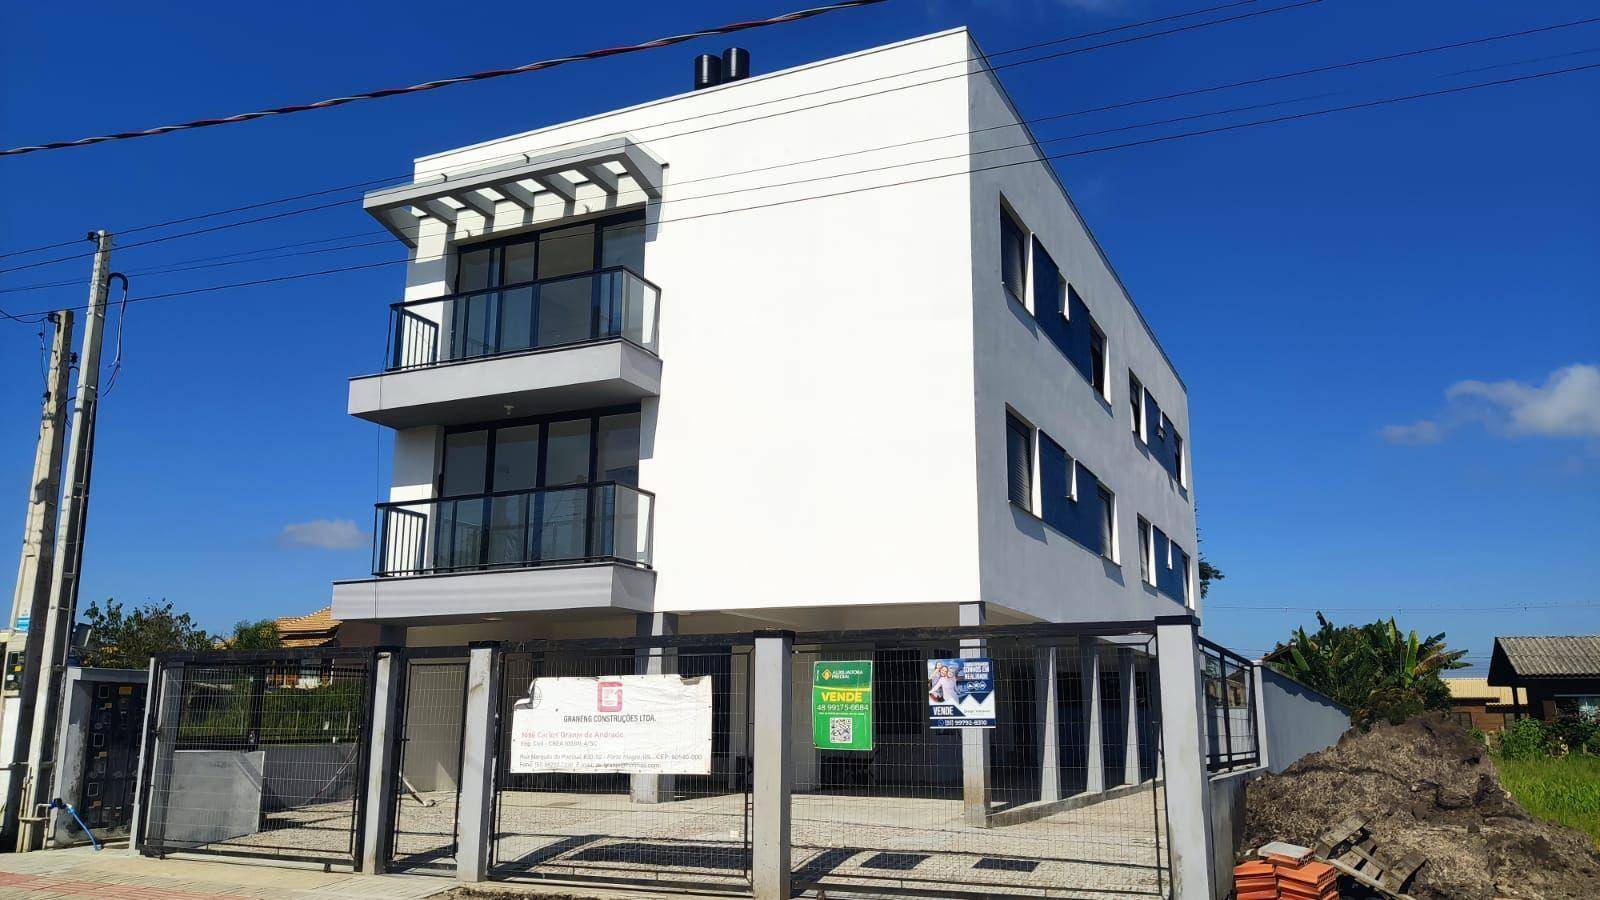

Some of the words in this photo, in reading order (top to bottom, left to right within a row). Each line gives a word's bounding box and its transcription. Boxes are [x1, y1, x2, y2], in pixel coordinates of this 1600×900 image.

[821, 691, 863, 702] VENDE
[933, 706, 954, 716] VENDE
[593, 714, 639, 724] CONSTRUÇÕES
